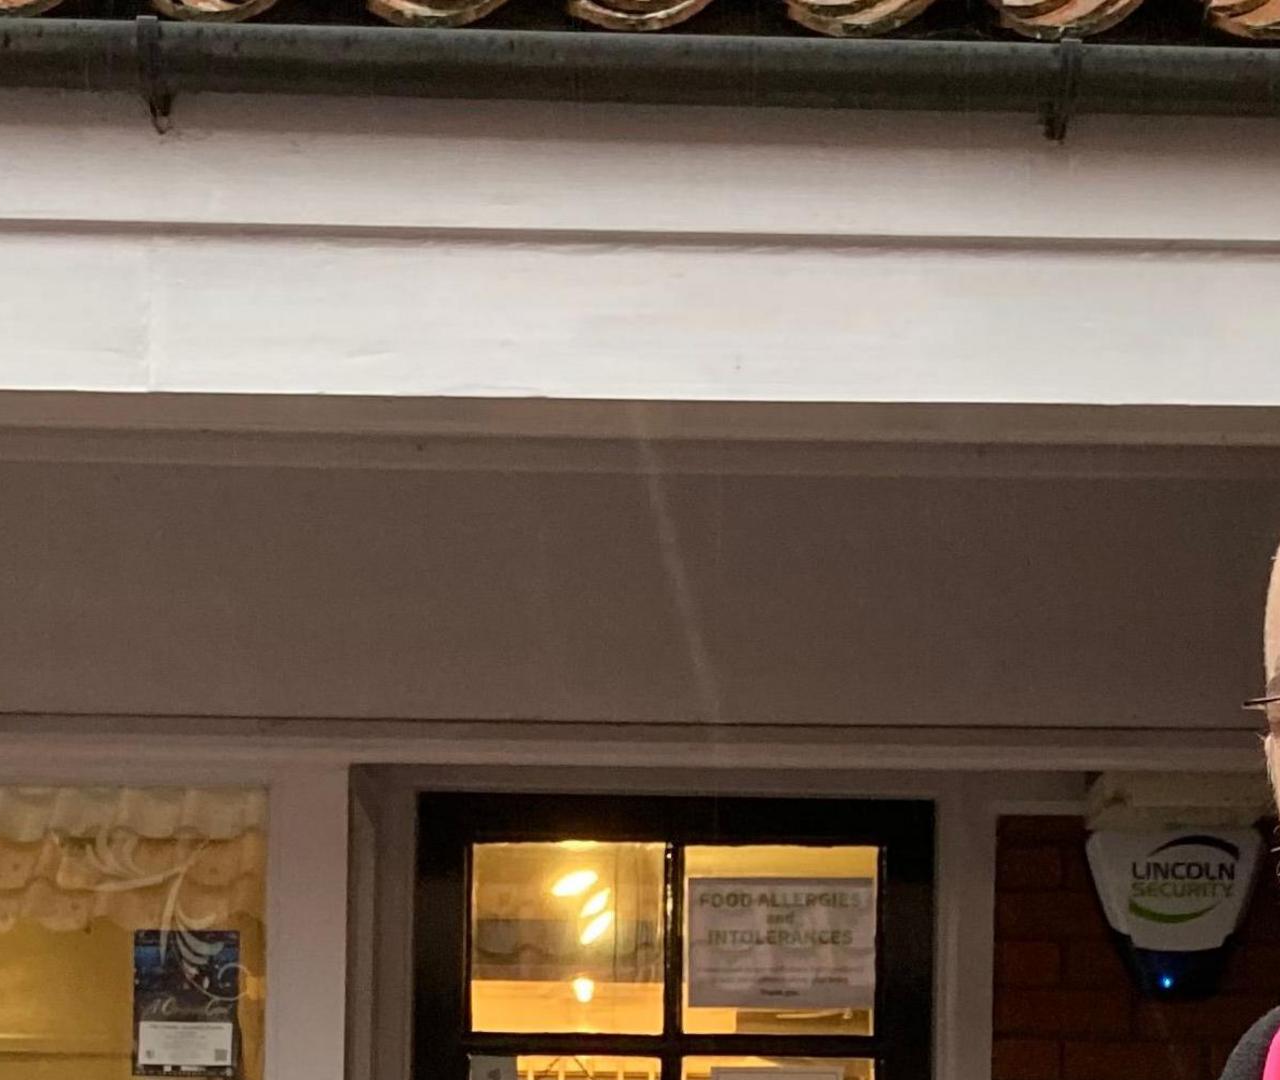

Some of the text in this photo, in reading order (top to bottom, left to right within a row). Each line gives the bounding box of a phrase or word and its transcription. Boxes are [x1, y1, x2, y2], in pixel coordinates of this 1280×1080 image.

[1131, 861, 1236, 881] LINCOLN
[1131, 883, 1234, 899] SECURITY
[700, 892, 864, 908] FOOD ALLERGIES
[708, 929, 854, 946] INTOLERANCES
